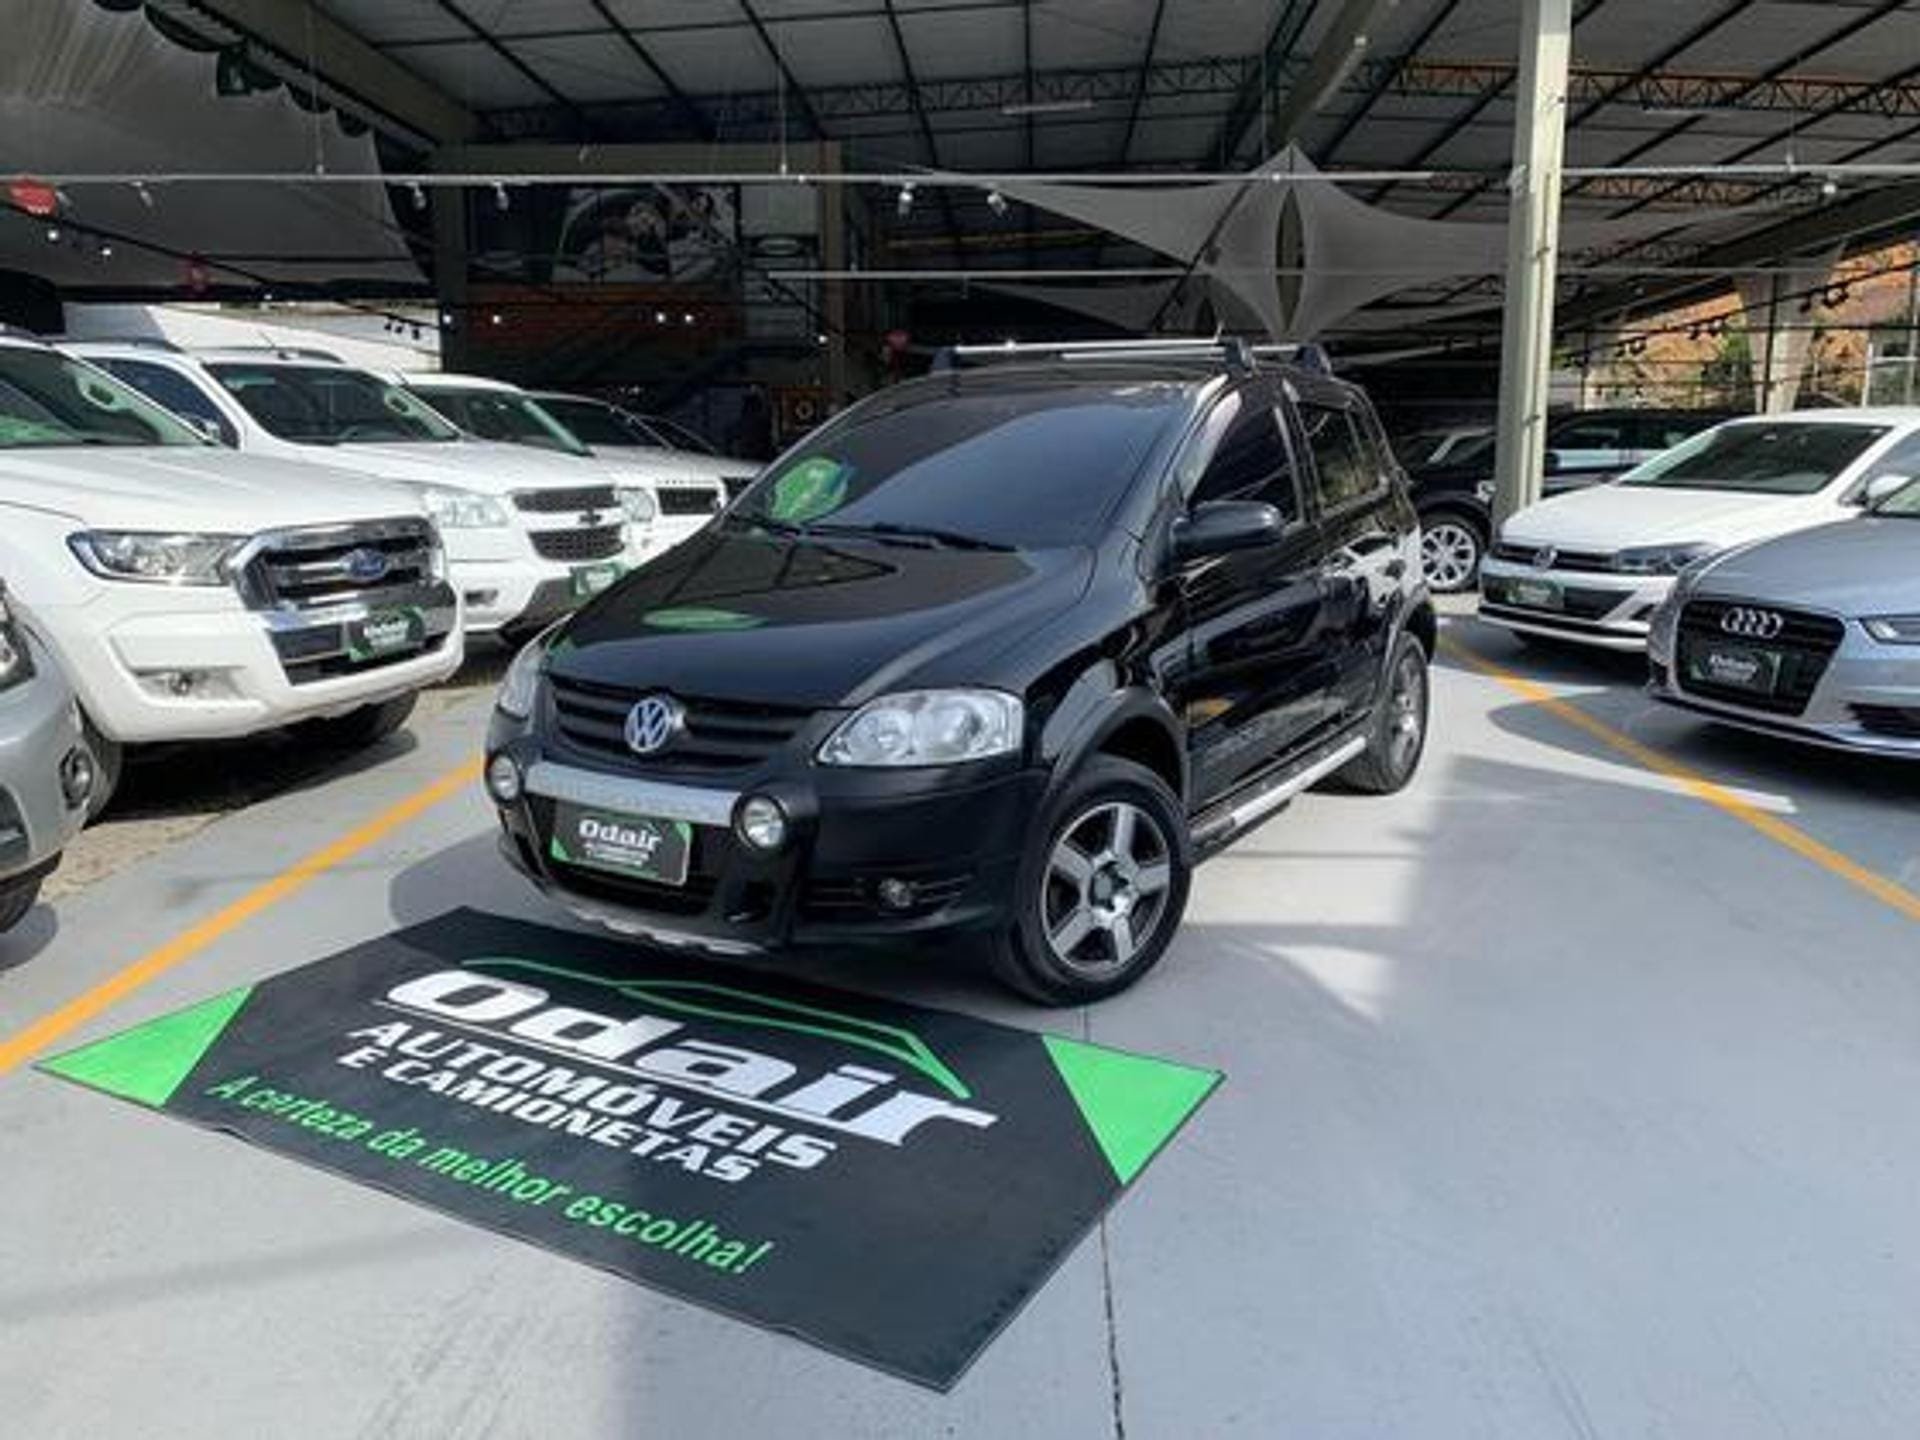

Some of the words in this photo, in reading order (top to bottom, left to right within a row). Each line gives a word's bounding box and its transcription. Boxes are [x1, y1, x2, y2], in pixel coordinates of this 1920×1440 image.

[579, 818, 662, 851] Odair
[336, 1046, 389, 1069] E
[383, 1059, 761, 1183] CAMIONETAS
[347, 1021, 838, 1169] AUTOMÓVEIS
[387, 970, 998, 1147] Odair
[205, 1075, 259, 1099] A
[240, 1088, 374, 1140] certeza
[366, 1127, 427, 1159] da
[418, 1147, 573, 1206] melhor
[564, 1195, 775, 1275] escolha!
